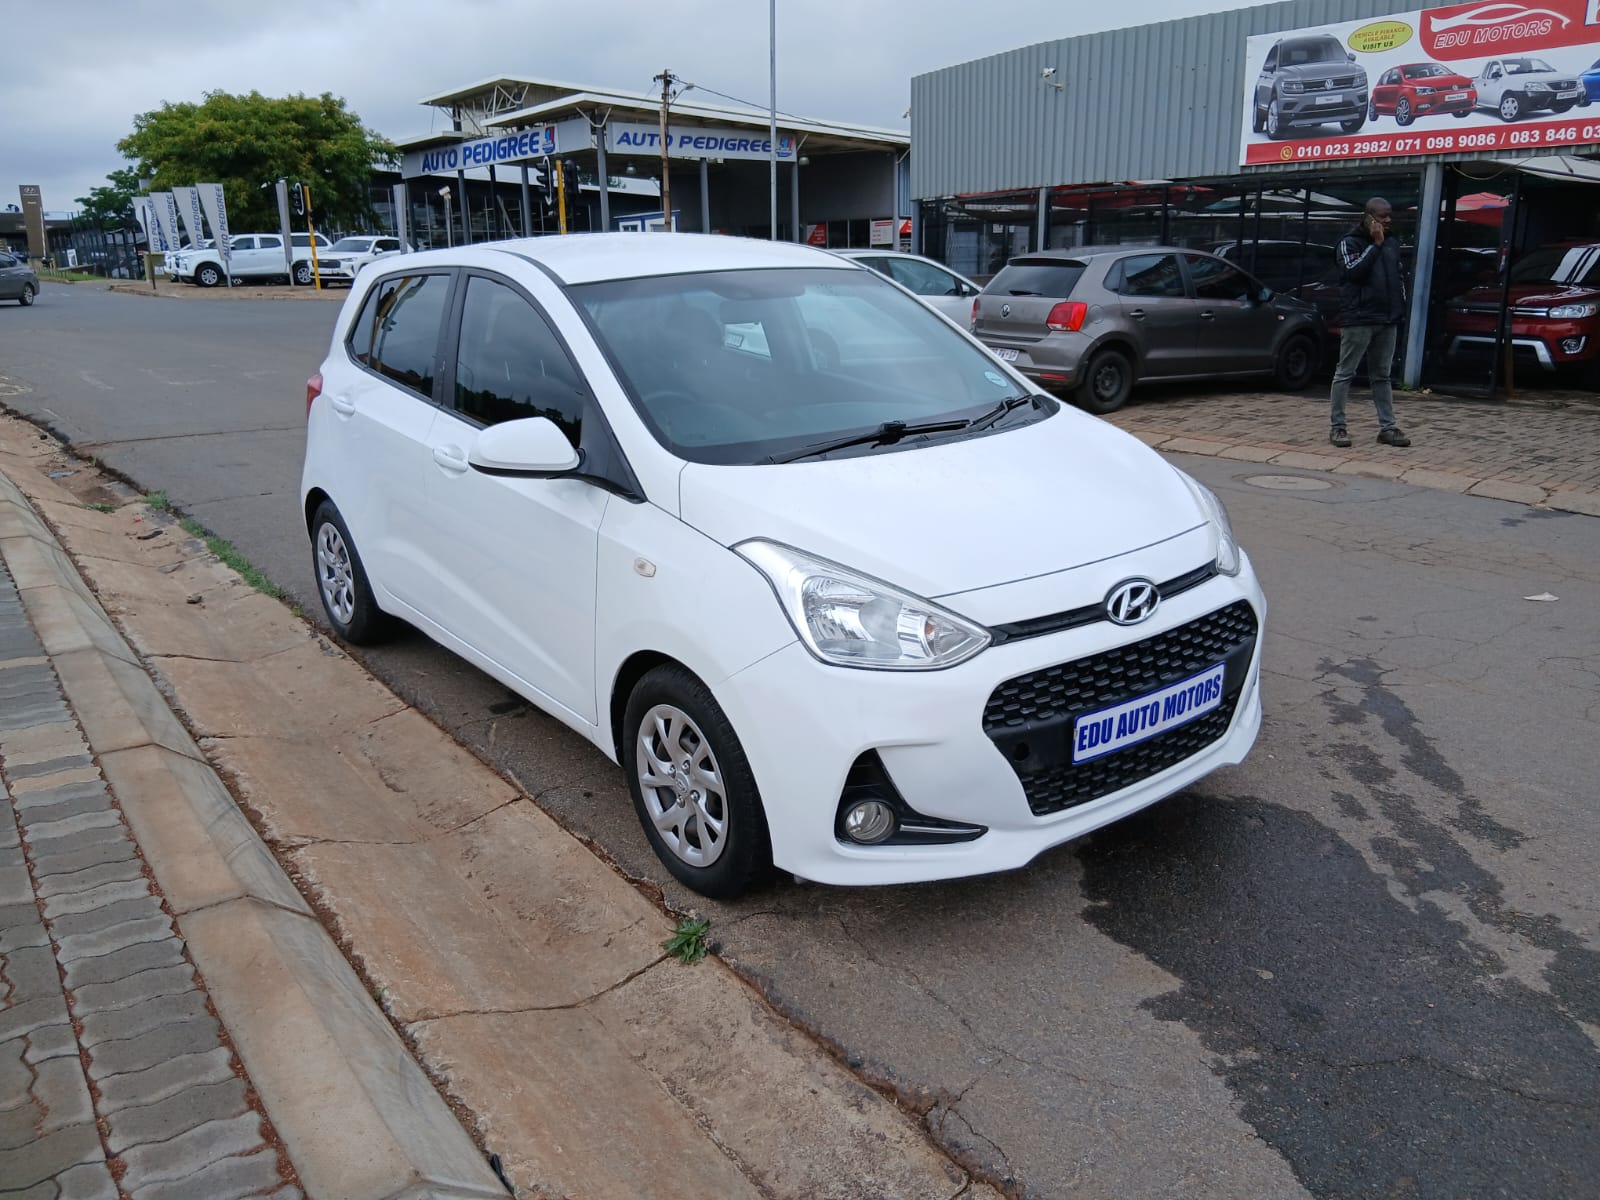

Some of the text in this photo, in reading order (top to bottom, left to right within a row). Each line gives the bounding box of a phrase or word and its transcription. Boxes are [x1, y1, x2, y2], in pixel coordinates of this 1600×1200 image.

[1362, 42, 1382, 50] VISIT
[1363, 34, 1396, 42] AVAILABLE
[1380, 27, 1406, 35] FINANCE
[1433, 19, 1552, 49] EDU MOTORS
[422, 131, 540, 173] AUTO PEDIGREE
[616, 131, 772, 153] AUTO PEDIGREE
[1297, 146, 1322, 158] 010
[1325, 143, 1349, 156] 023
[1395, 138, 1421, 151] 071
[1426, 136, 1453, 149] 098
[1458, 133, 1496, 147] 9086
[1510, 130, 1540, 144] 083
[1545, 127, 1577, 142] 846
[190, 188, 201, 231] PEDIGREE
[215, 184, 231, 257] AUTO PEDIGREE
[1078, 674, 1221, 752] EDU AUTO MOTORS
